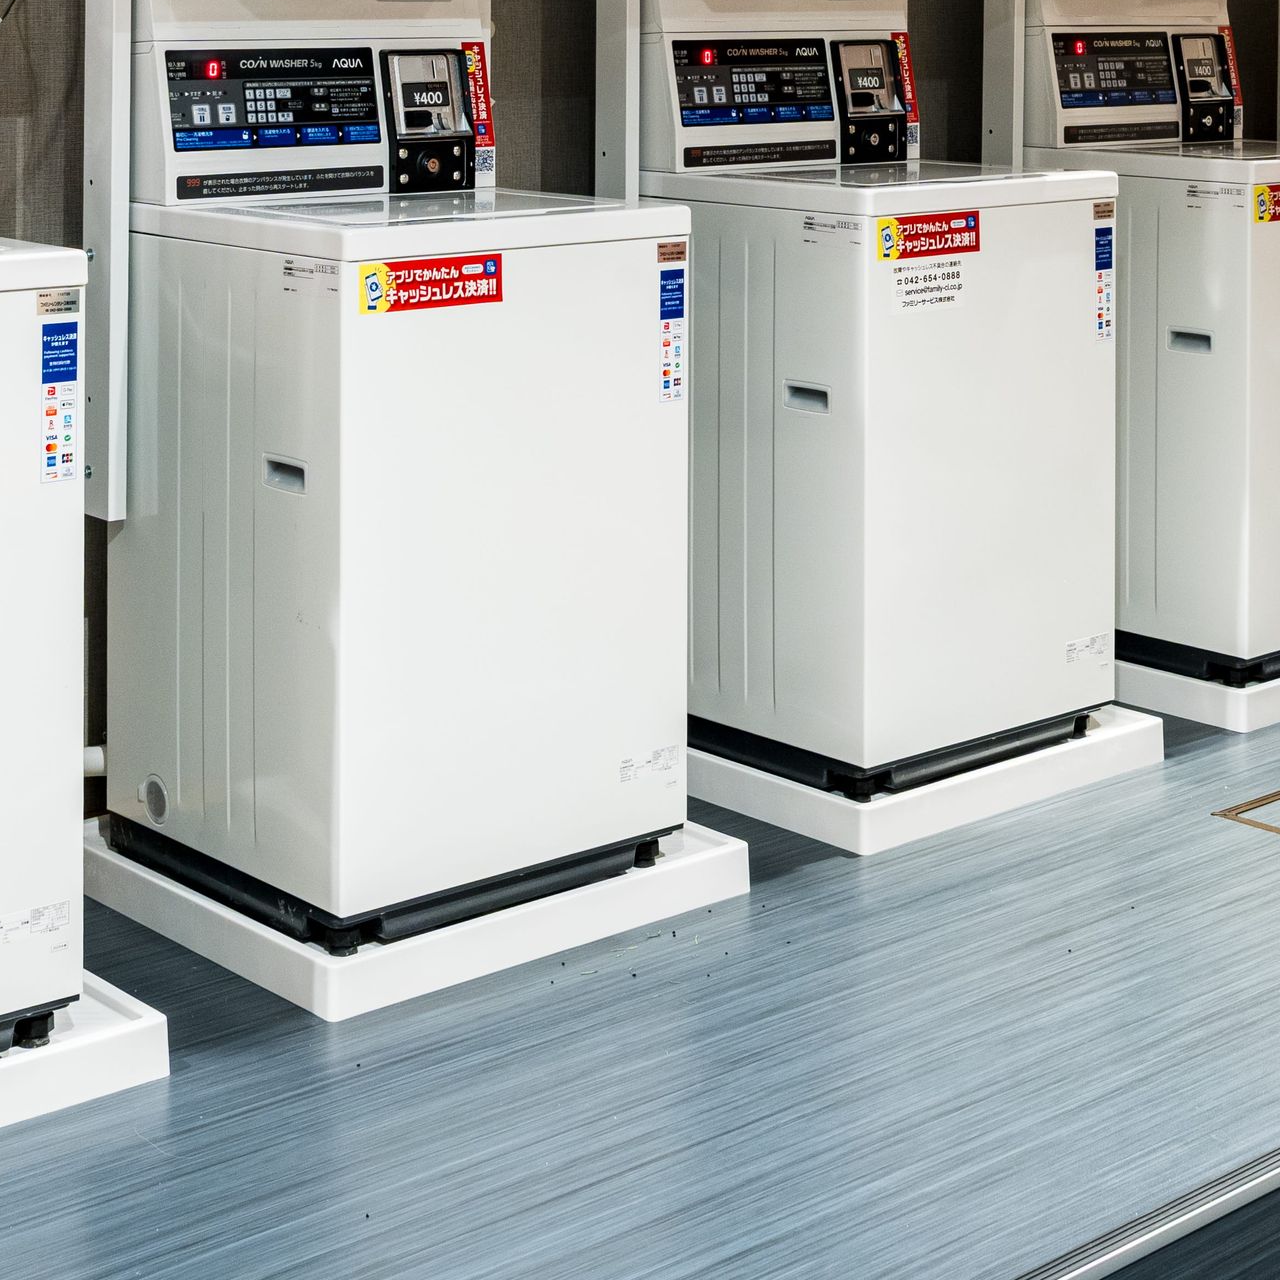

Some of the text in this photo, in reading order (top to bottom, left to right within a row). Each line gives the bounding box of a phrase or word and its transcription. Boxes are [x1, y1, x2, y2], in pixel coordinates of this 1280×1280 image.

[1145, 40, 1163, 48] AQUA
[749, 48, 778, 56] WASHER
[795, 47, 818, 56] AQUA
[209, 63, 217, 76] 0
[270, 59, 308, 68] WASHER
[332, 59, 363, 68] AQUA
[472, 45, 487, 120] キャッシュレス決済
[857, 77, 879, 88] ¥400
[414, 92, 442, 105] ¥400
[896, 222, 948, 236] アプリでかんたん
[385, 265, 459, 285] アプリでかんたん
[904, 271, 961, 286] 042-654-0888
